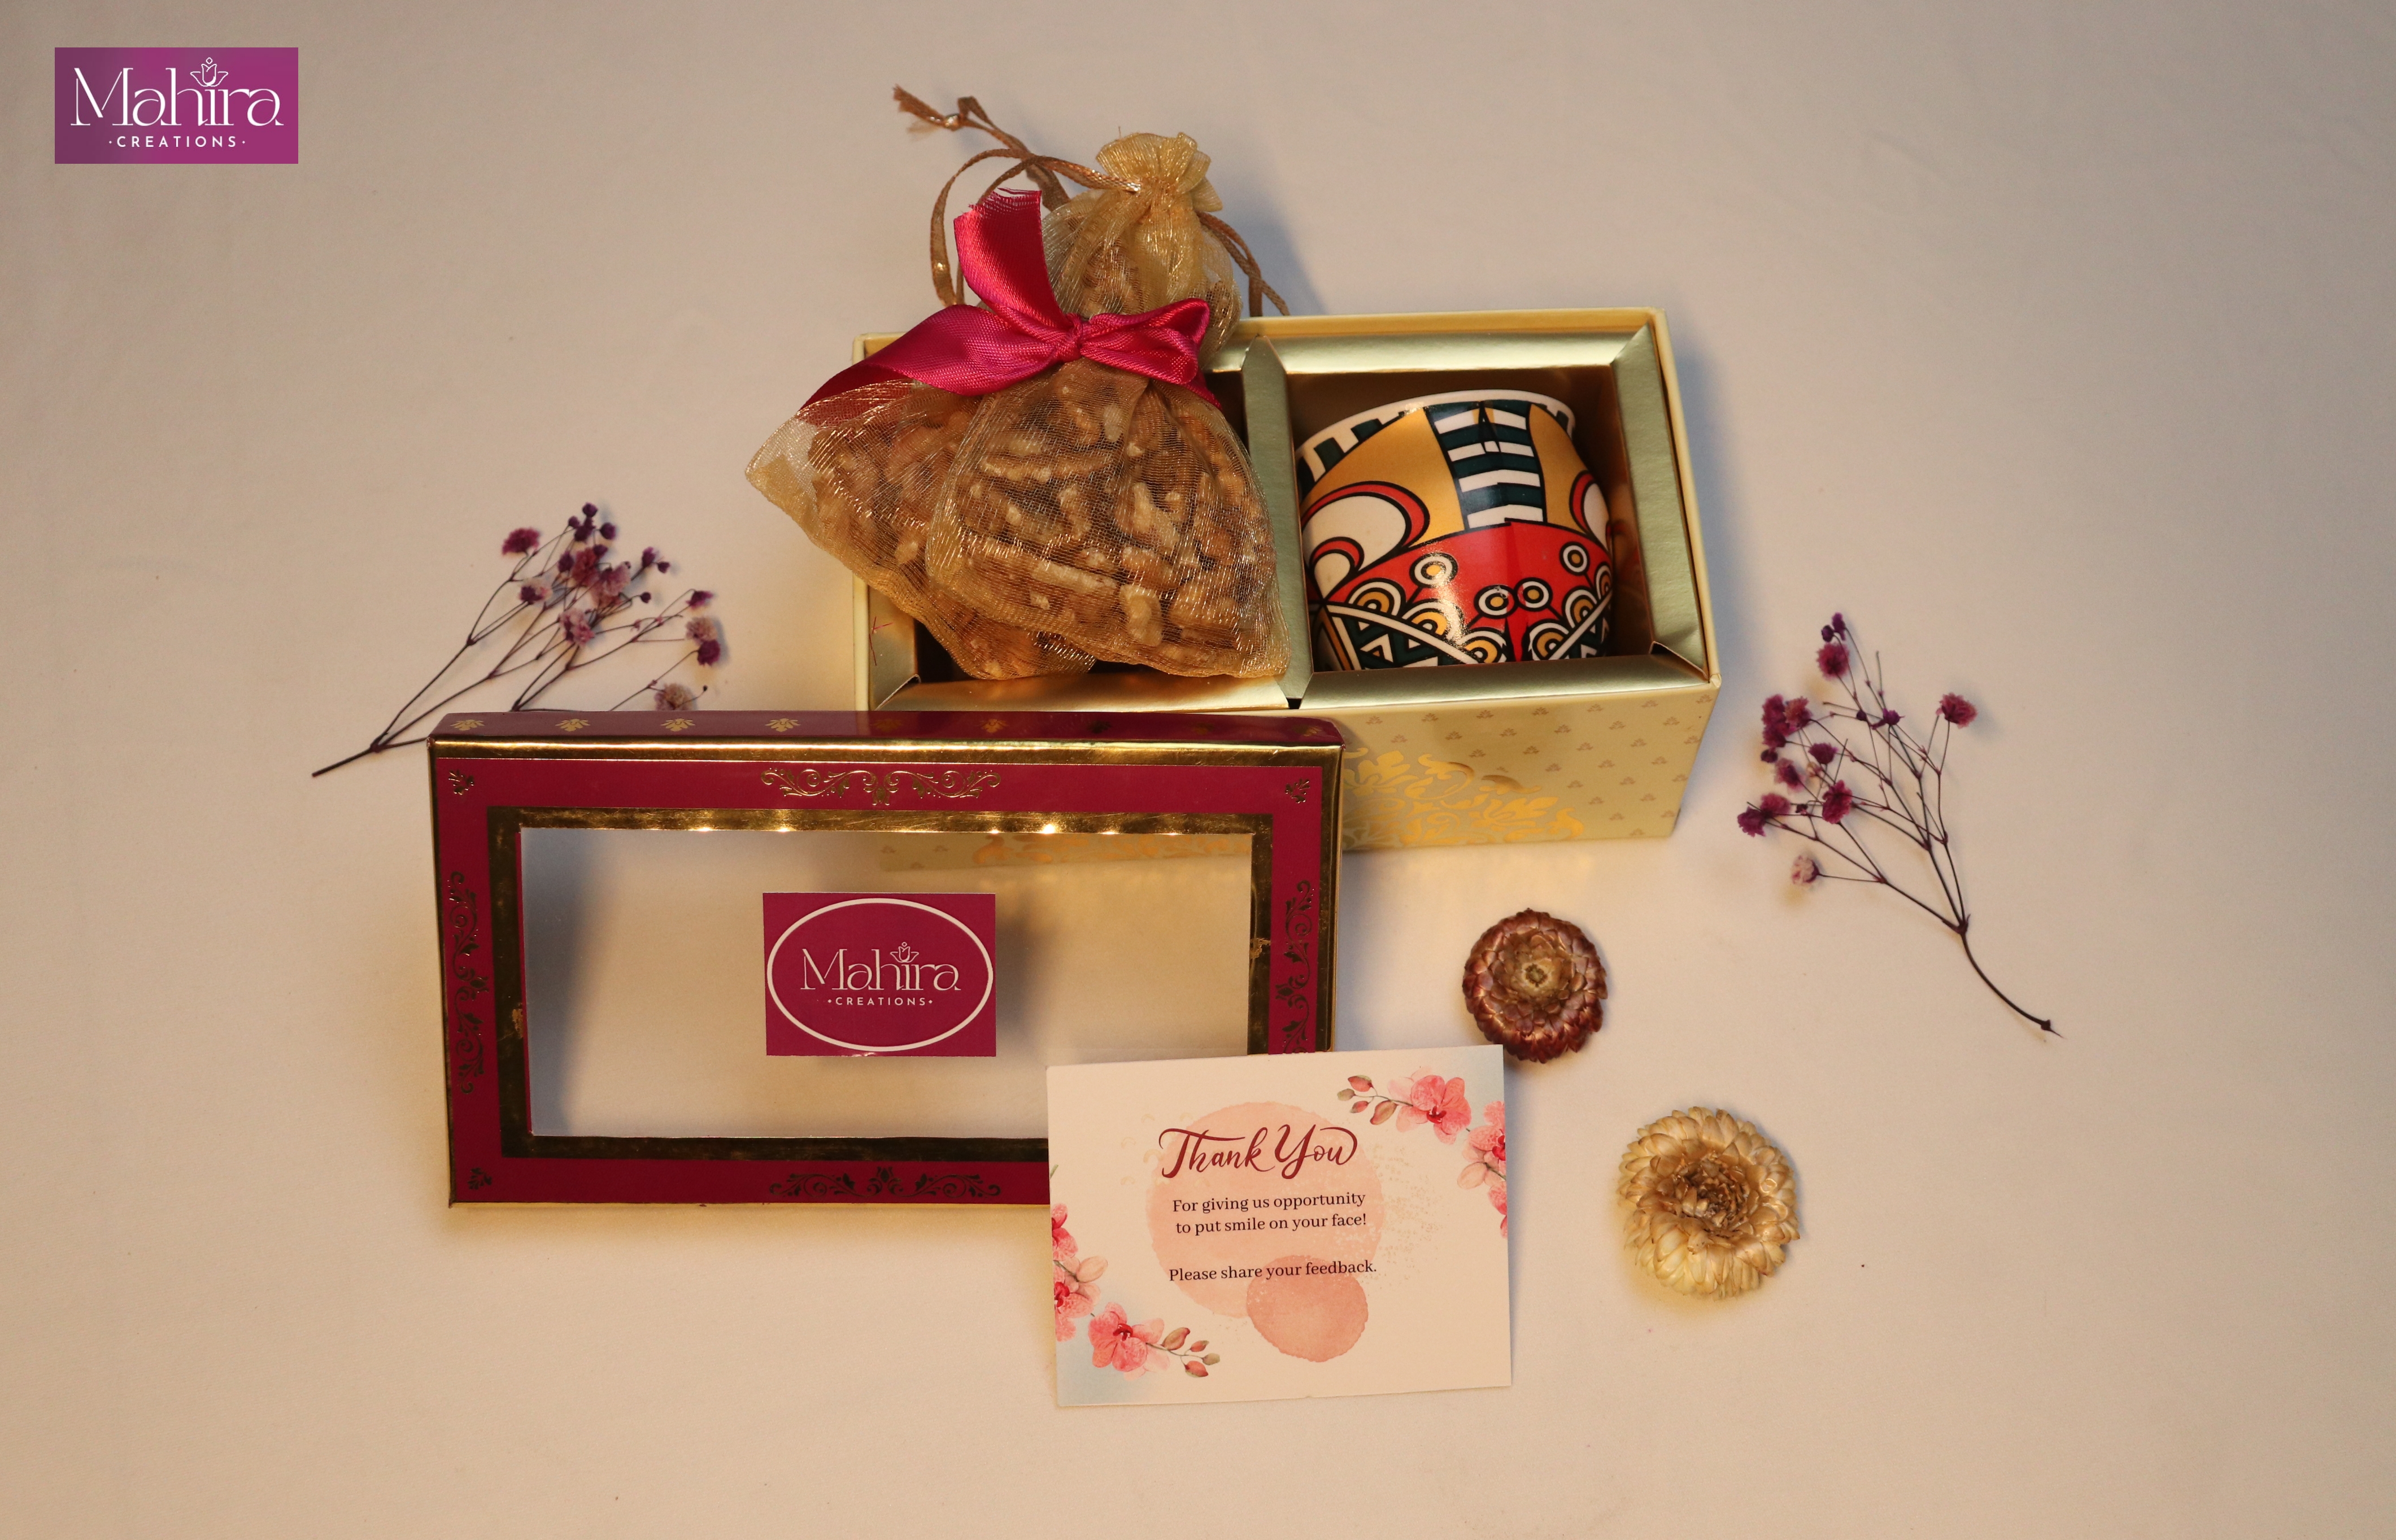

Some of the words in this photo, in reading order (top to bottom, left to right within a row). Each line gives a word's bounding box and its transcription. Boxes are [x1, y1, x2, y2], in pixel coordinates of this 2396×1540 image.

[800, 941, 961, 991] Mahira
[1158, 1127, 1276, 1179] Thank
[1275, 1124, 1358, 1179] You
[1173, 1199, 1198, 1212] For
[1202, 1197, 1249, 1214] giving
[1253, 1198, 1270, 1209] us
[1274, 1192, 1366, 1211] opportunity
[1176, 1222, 1191, 1234] to
[1195, 1220, 1222, 1236] put
[1225, 1217, 1266, 1231] smile
[1269, 1219, 1288, 1229] on
[1292, 1218, 1328, 1232] your
[1331, 1213, 1366, 1227] face!
[1170, 1268, 1217, 1281] Please
[1221, 1266, 1262, 1279] share
[1266, 1266, 1302, 1281] your
[1306, 1259, 1377, 1276] feedback.
